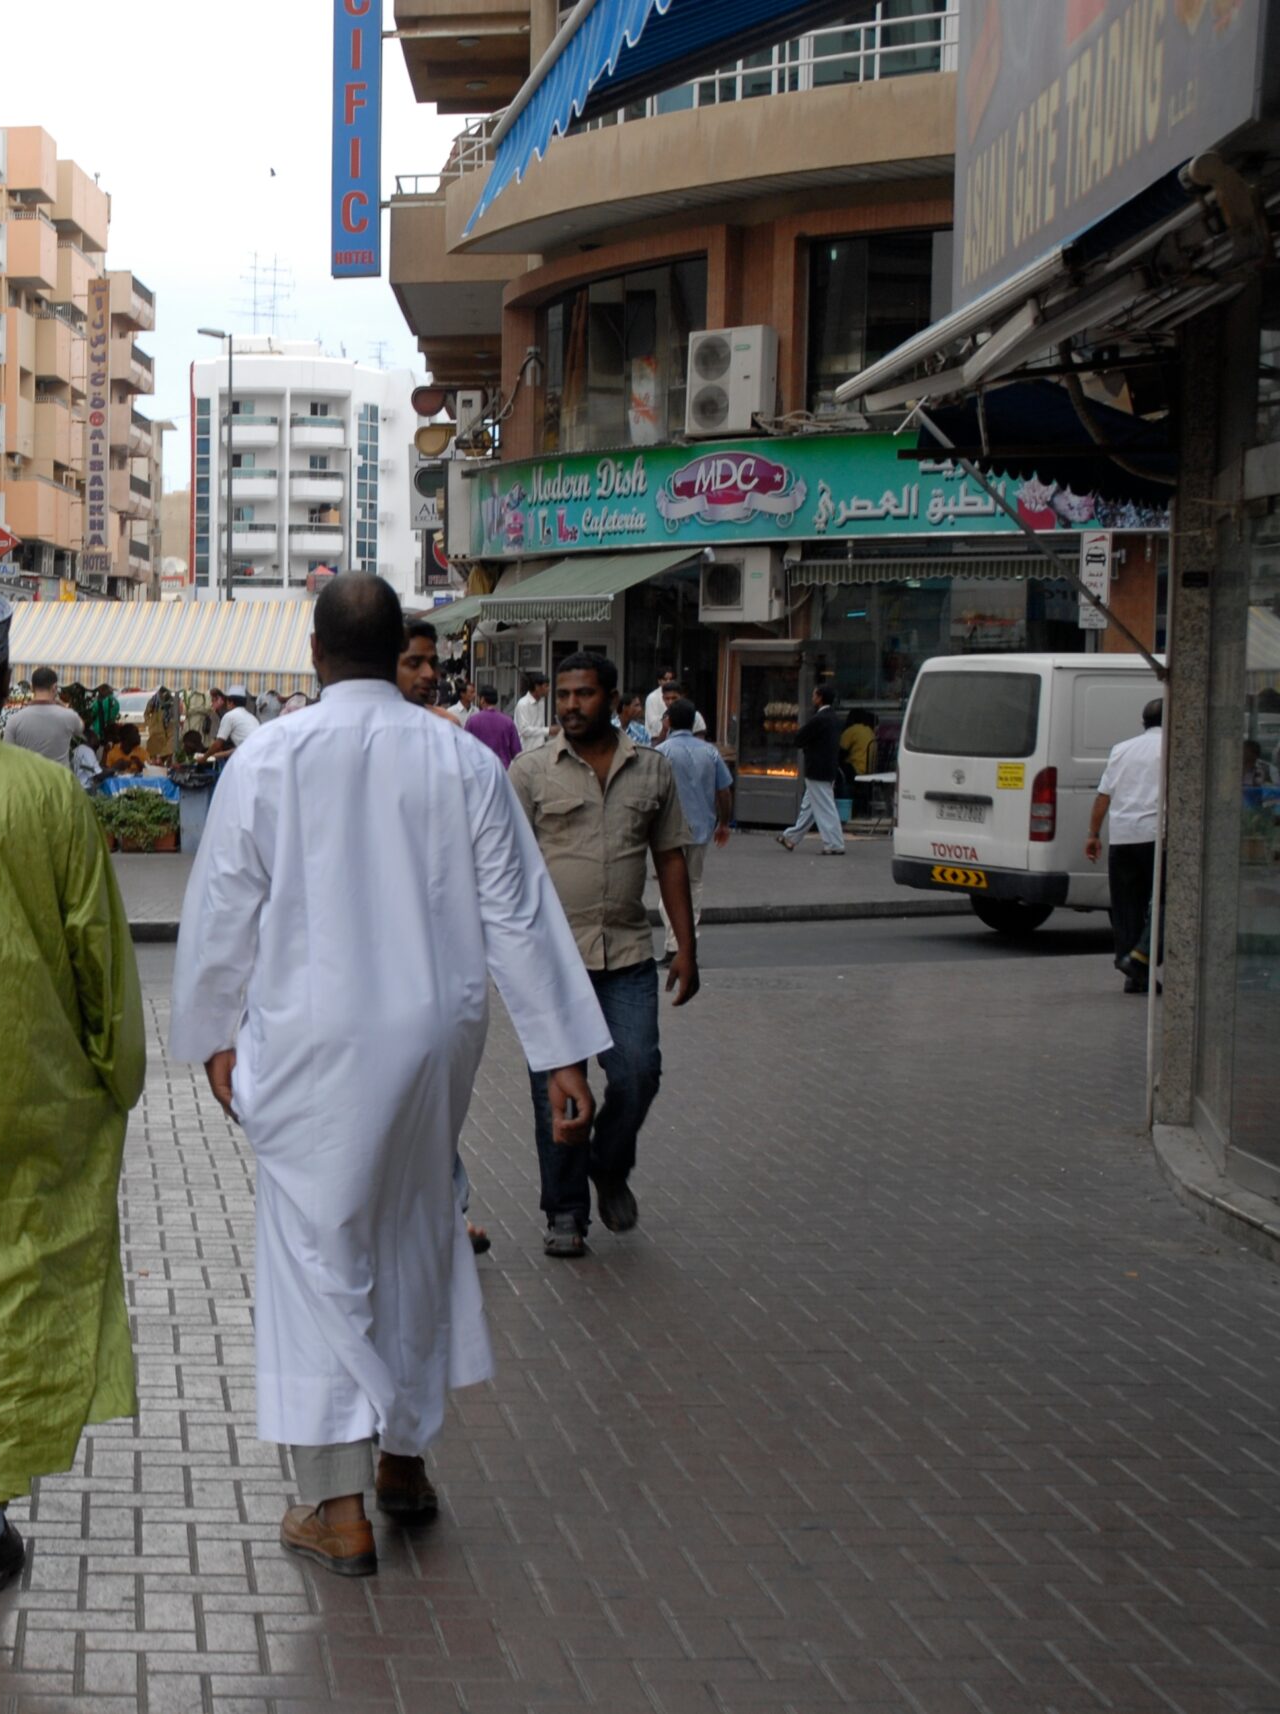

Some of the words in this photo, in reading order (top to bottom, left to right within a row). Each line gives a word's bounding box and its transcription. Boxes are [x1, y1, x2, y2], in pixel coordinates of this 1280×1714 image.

[962, 127, 1009, 288] ASIAN
[1013, 77, 1060, 249] GATE
[1065, 0, 1167, 209] TRADING
[335, 250, 374, 265] HOTEL
[528, 463, 591, 506] Modern
[596, 454, 648, 498] Dish
[694, 457, 759, 494] MDC
[813, 479, 920, 533] العصري
[926, 480, 1006, 525] الطبق
[582, 507, 647, 543] Cafeteria
[82, 553, 111, 572] HOTEL
[931, 842, 979, 862] TOYOTA
